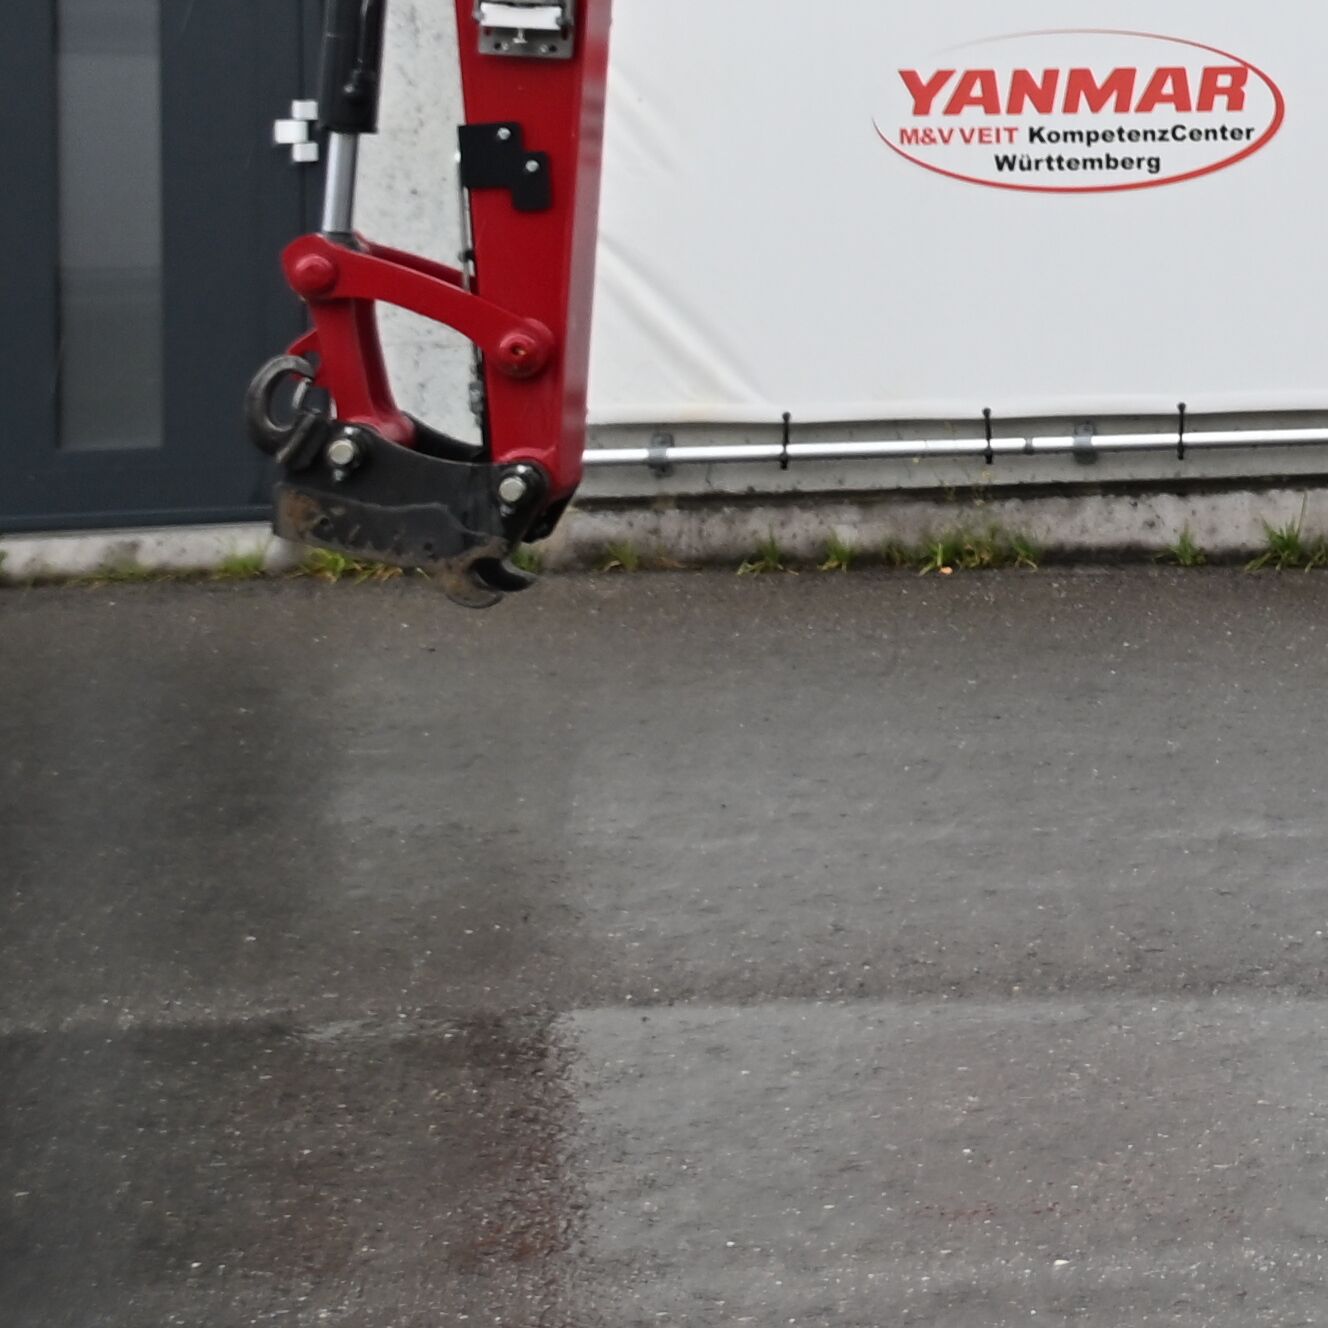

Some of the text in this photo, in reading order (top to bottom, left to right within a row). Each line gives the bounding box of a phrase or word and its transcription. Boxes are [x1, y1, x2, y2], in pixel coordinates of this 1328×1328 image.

[898, 68, 1249, 115] YANMAR
[900, 123, 1255, 147] M&V VEIT KompetenzCenter
[994, 152, 1161, 176] Württemberg
